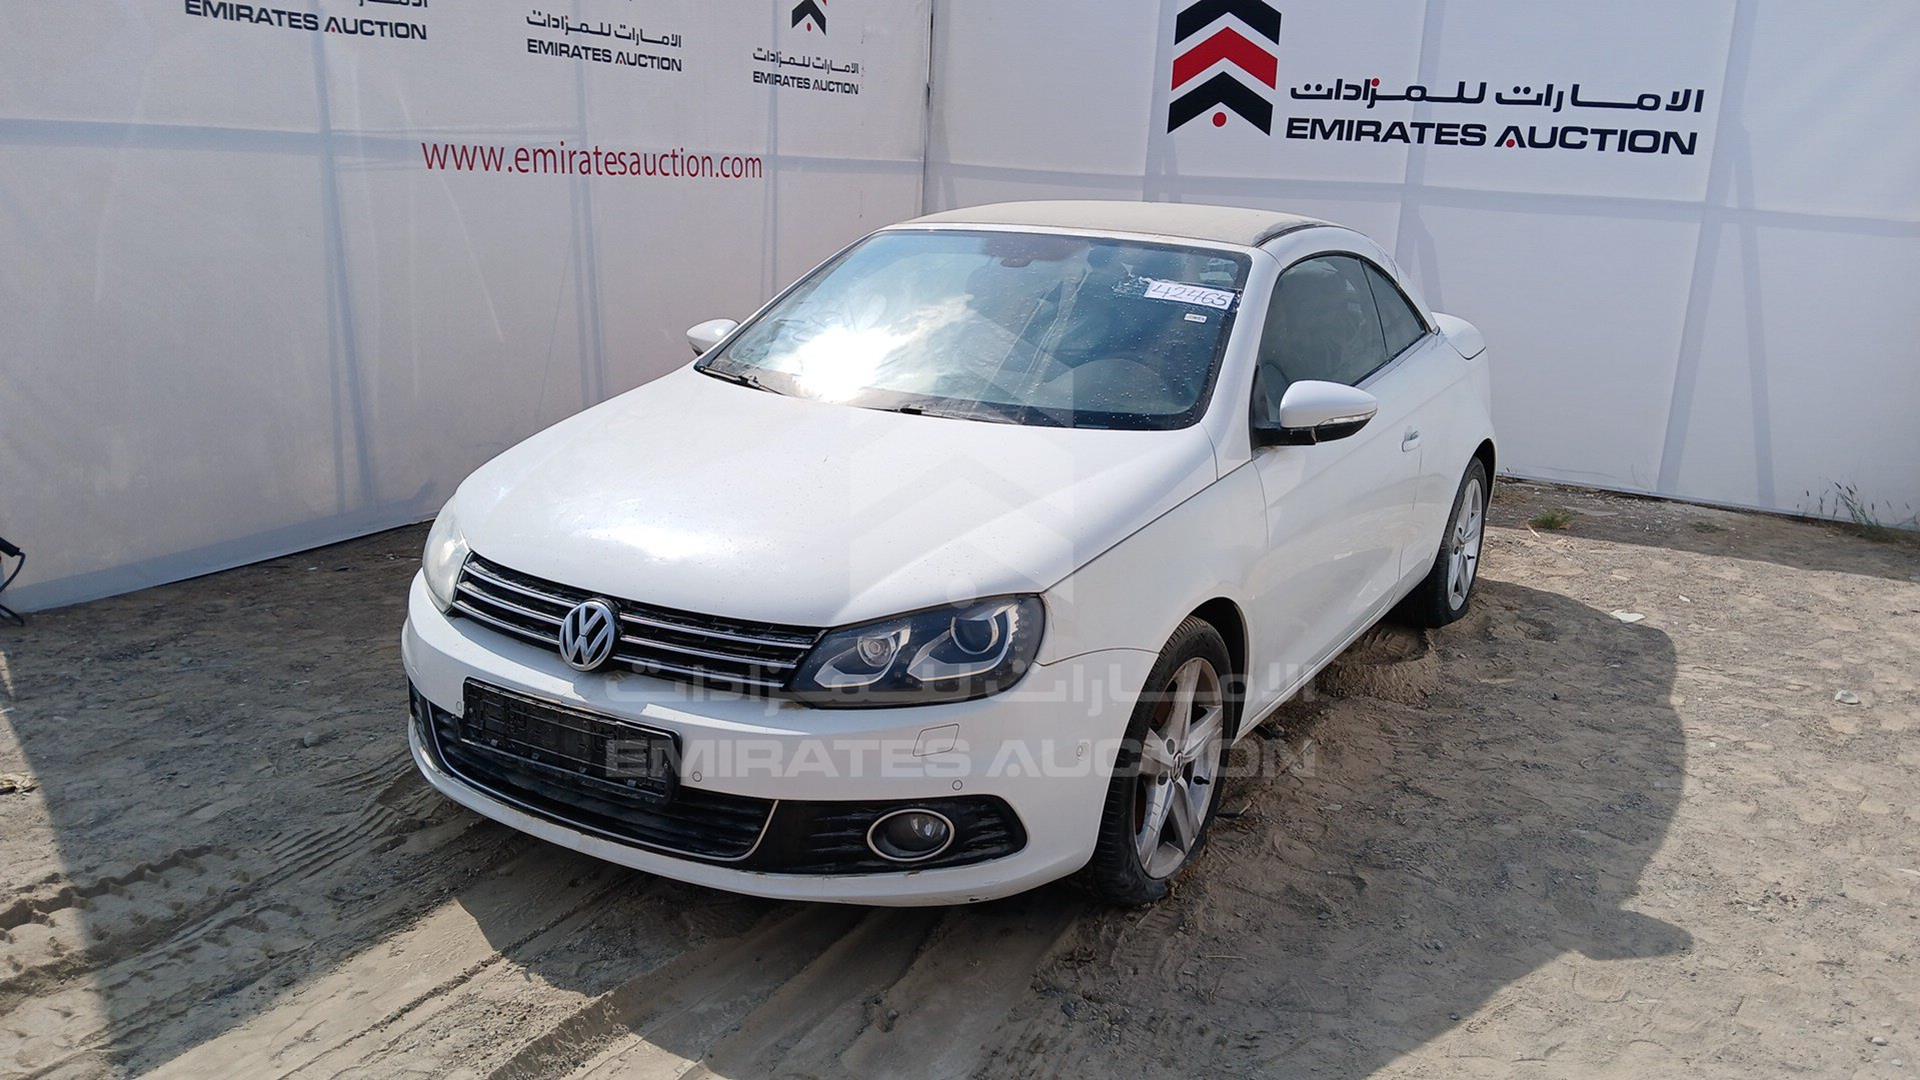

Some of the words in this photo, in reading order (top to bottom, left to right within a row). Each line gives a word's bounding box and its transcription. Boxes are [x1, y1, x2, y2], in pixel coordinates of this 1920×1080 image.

[185, 0, 319, 31] EMIRATES
[324, 16, 427, 40] AUCTION
[527, 38, 612, 63] EMIRATES
[615, 51, 682, 72] AUCTION
[753, 71, 811, 90] EMIRATES
[812, 79, 859, 95] AUCTION
[1285, 118, 1487, 147] EMIRATES
[1494, 124, 1698, 155] AUCTION
[421, 141, 763, 178] www.emiratesauction.com
[1151, 283, 1231, 307] 42465
